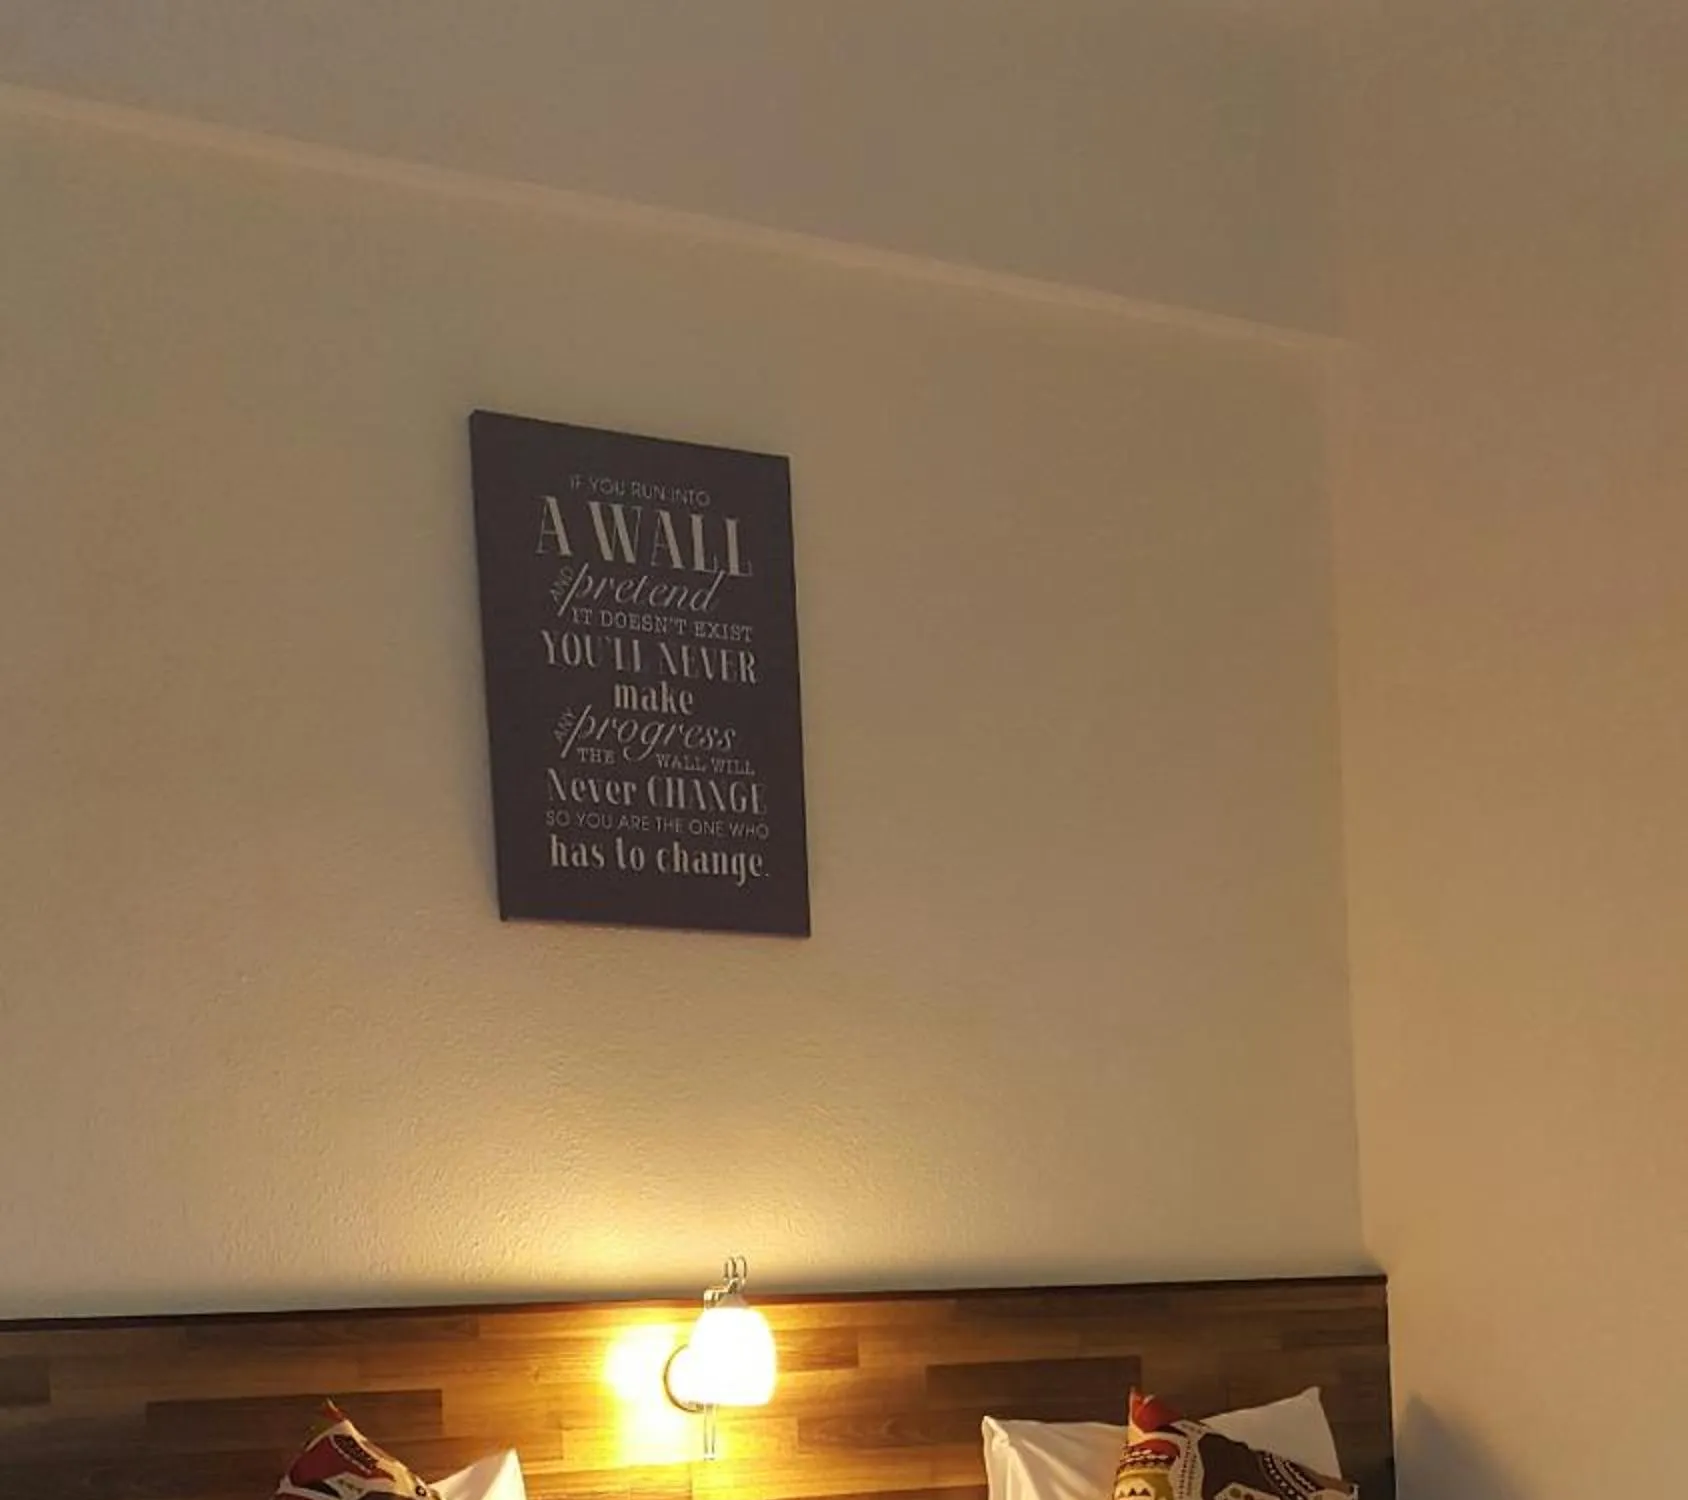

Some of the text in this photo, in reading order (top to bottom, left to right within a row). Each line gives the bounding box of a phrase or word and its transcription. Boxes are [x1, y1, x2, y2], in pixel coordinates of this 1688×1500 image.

[570, 474, 711, 507] IF YOU RUN INTO
[535, 495, 753, 577] A WALL
[557, 562, 726, 617] pretend
[572, 607, 754, 643] IT DOESN'T EXIST
[541, 629, 757, 684] YOU'LL NEVER
[613, 680, 694, 716] make
[560, 704, 736, 762] progress
[577, 747, 756, 776] THE WALL WILL
[547, 767, 768, 815] Never CHANGE
[545, 809, 769, 841] SO YOU ARE THE ONE WHO
[550, 832, 605, 869] has
[615, 837, 646, 872] to
